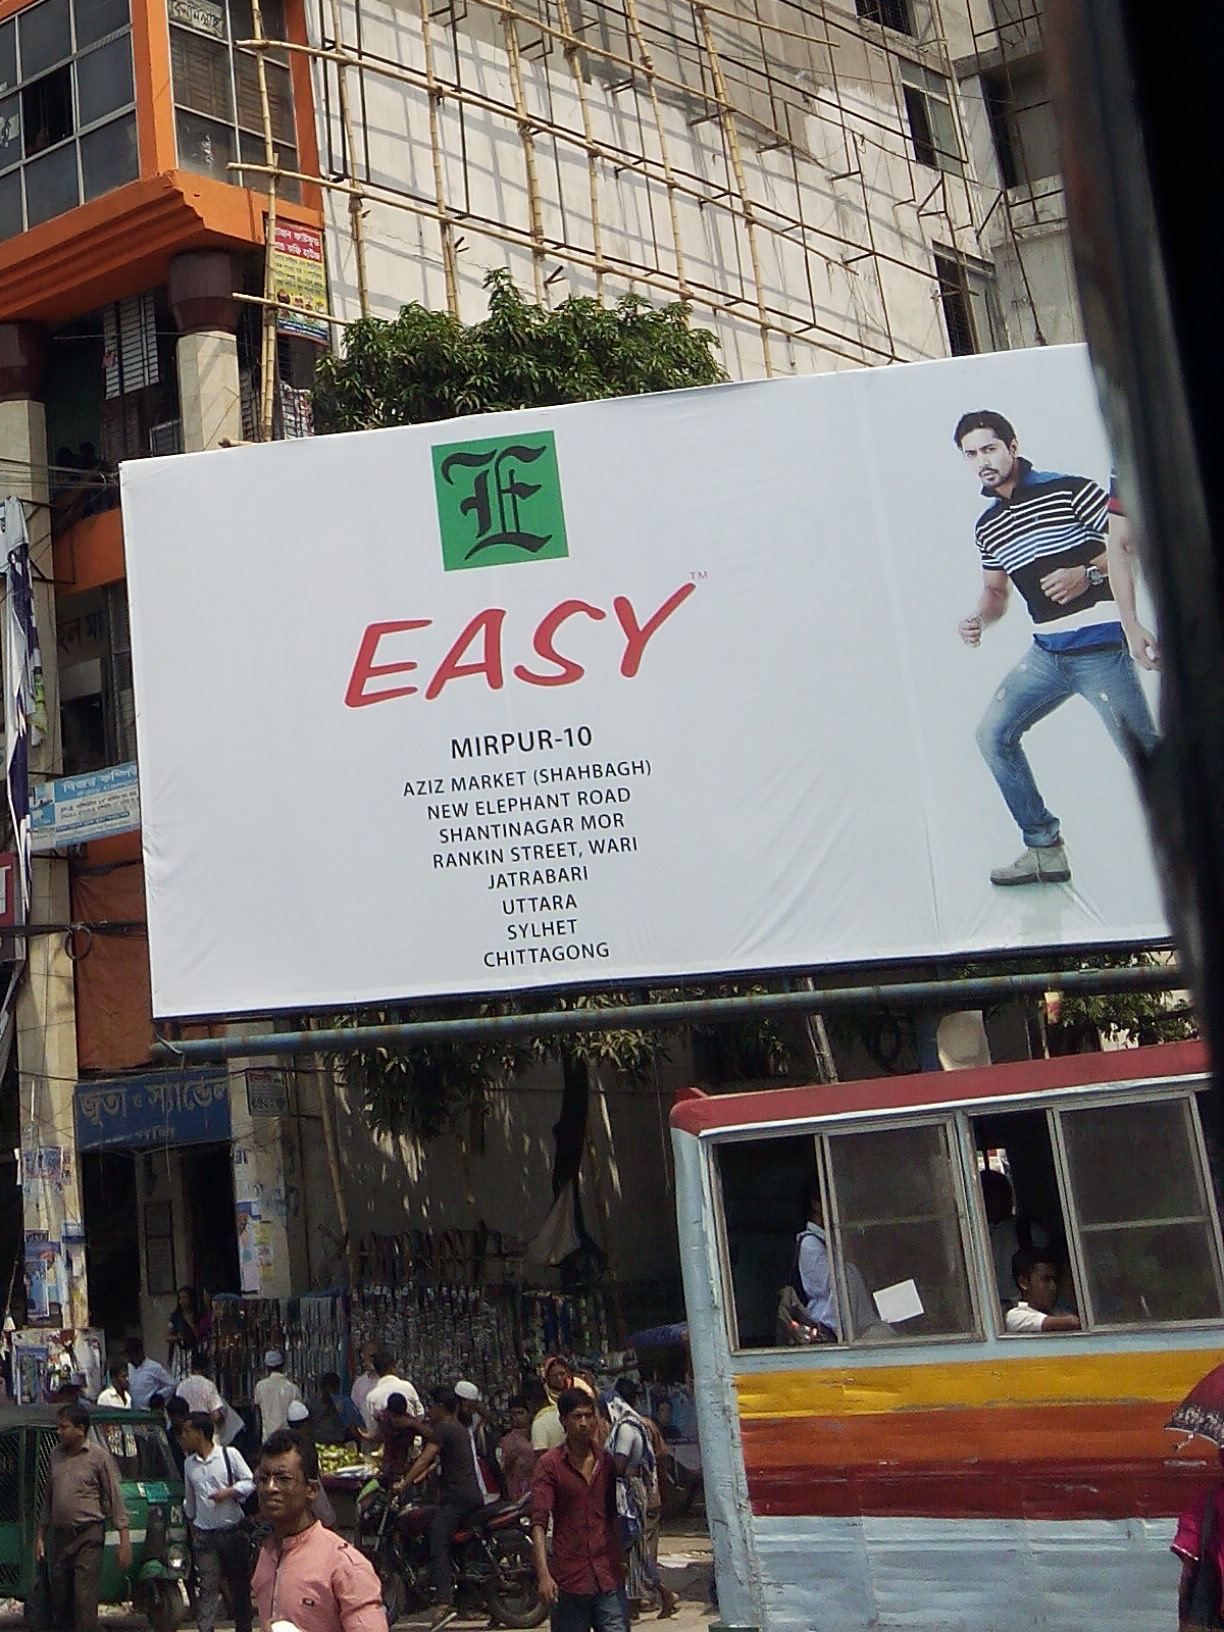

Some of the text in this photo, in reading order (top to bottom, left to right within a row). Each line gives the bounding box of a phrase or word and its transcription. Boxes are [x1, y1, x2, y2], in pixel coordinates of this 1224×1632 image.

[344, 581, 697, 708] EASY
[451, 726, 593, 759] MIRPUR-10
[403, 759, 652, 797] AZIZ MARKET (SHAHBAGH)
[427, 787, 631, 820] NEW ELEPHANT ROAD
[439, 813, 625, 844] SHANTINAGAR MOR
[433, 836, 638, 869] RANKIN STREET, WARI
[488, 865, 588, 890] JATRABARI
[502, 893, 578, 915] UTTARA
[507, 919, 578, 940] SYLHET
[483, 942, 610, 967] CHITTAGONG
